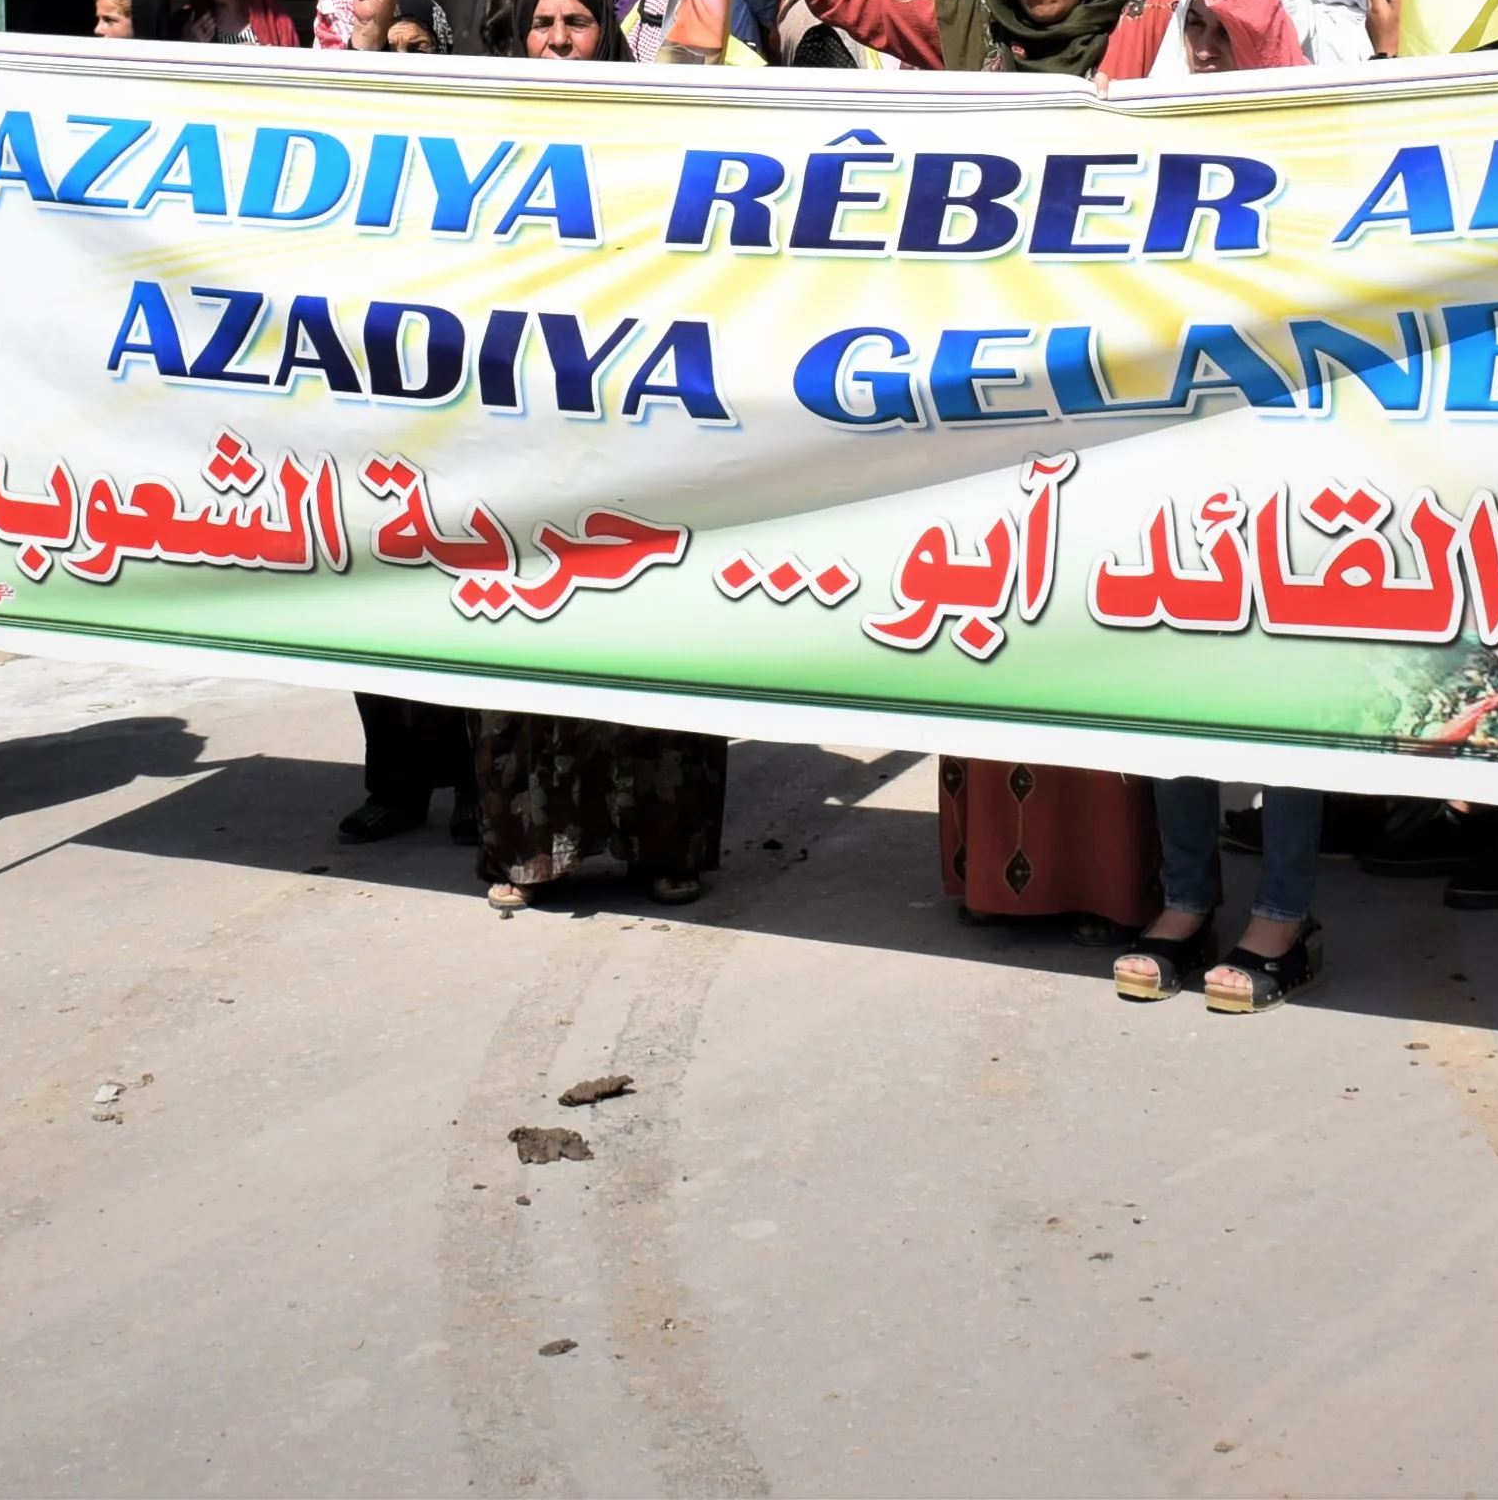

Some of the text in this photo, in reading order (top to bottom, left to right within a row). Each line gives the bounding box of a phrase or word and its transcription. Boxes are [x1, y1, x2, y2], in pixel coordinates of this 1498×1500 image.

[665, 129, 1280, 254] RÊBER
[106, 280, 733, 421] AZADIYA
[361, 459, 687, 617] حرية
